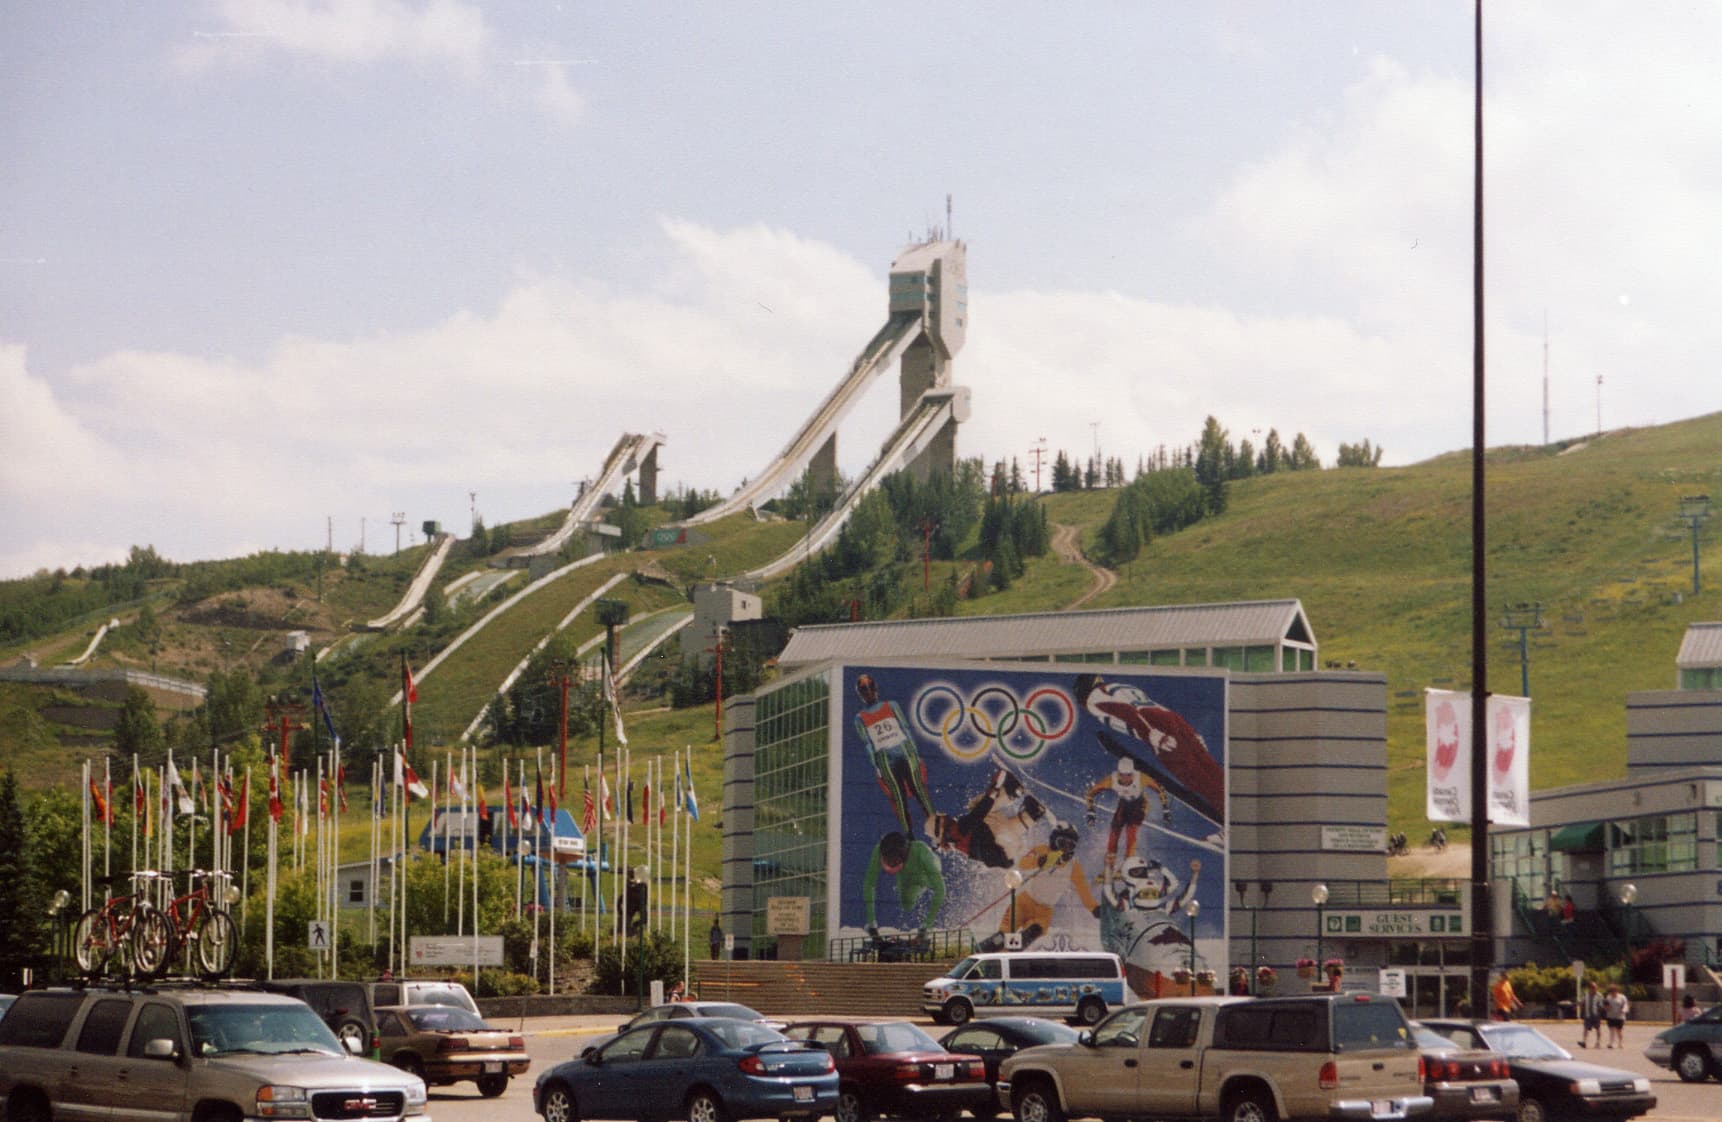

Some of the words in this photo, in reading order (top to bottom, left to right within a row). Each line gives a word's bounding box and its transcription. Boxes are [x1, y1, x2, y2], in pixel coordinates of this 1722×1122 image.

[875, 720, 892, 736] 26
[1376, 913, 1413, 923] GUEST
[1368, 924, 1422, 934] SERVICES
